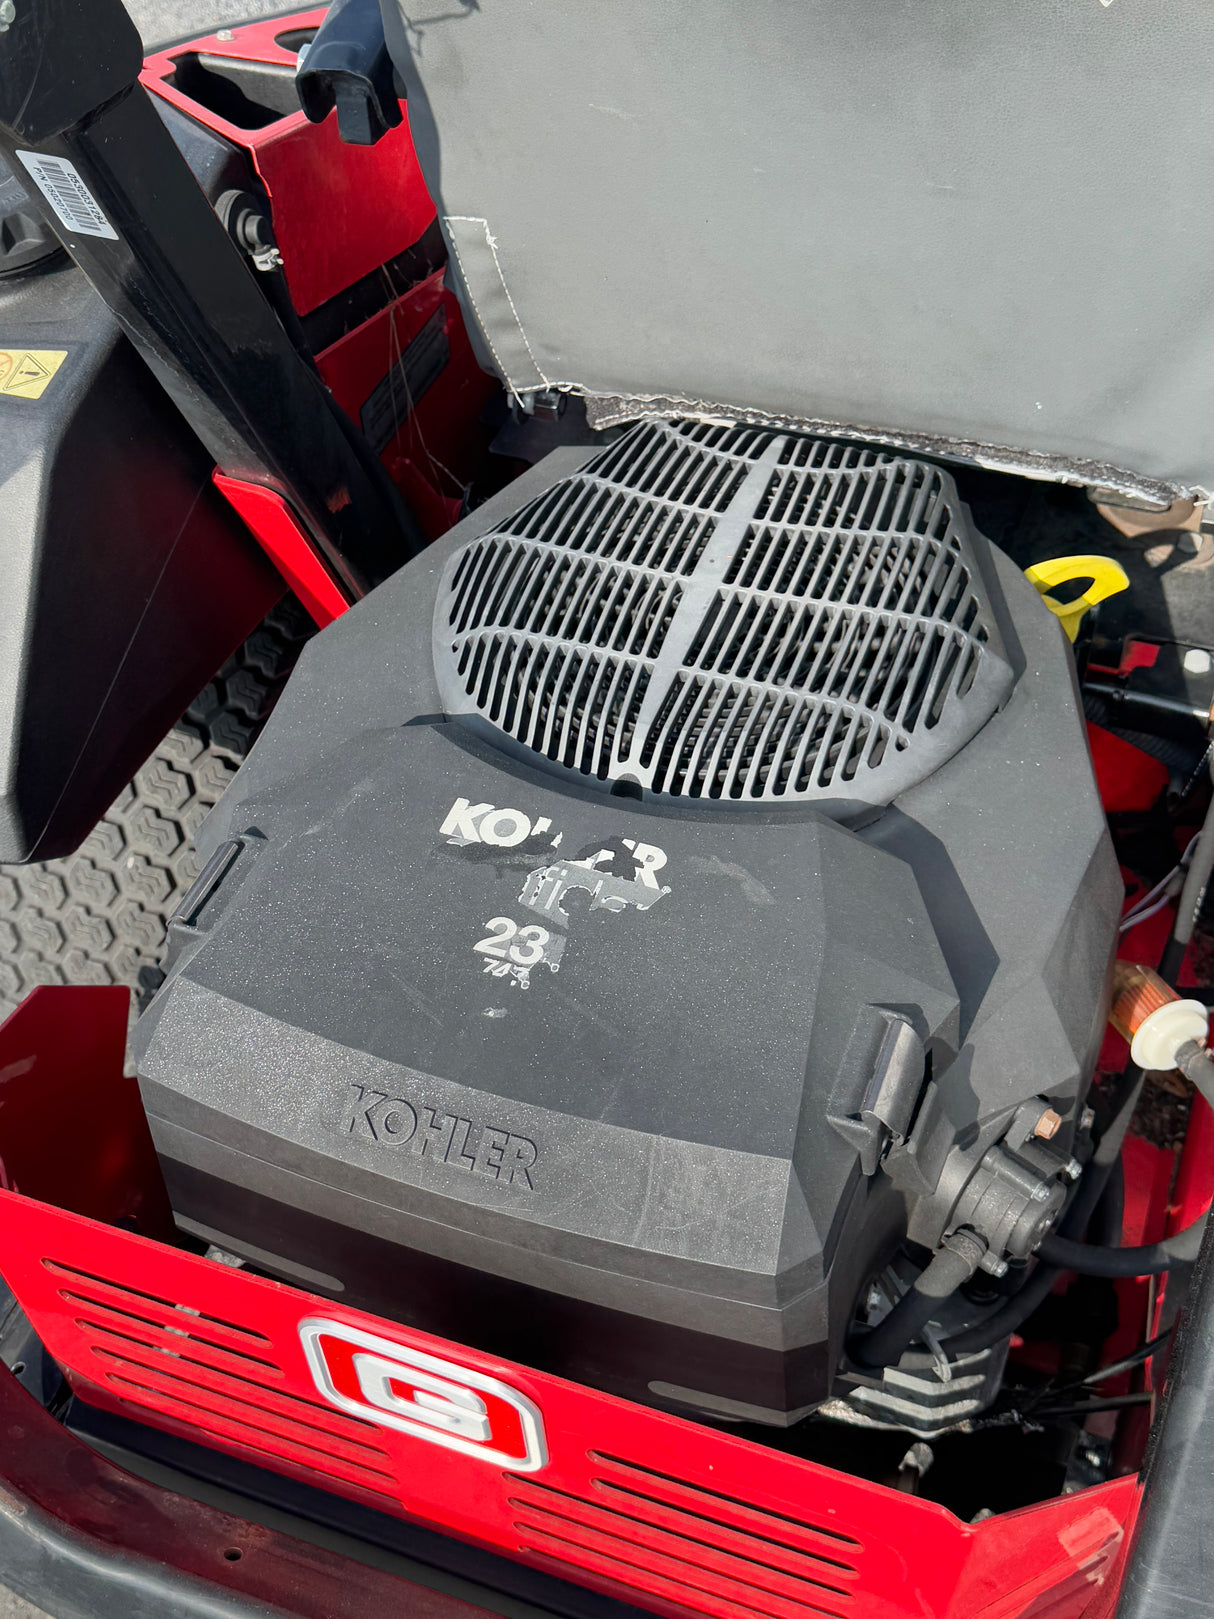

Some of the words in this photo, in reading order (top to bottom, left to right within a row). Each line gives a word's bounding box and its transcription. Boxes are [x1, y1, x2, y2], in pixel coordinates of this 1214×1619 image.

[33, 166, 49, 182] P/N
[472, 916, 550, 965] 23
[341, 1084, 538, 1191] KOHLER
